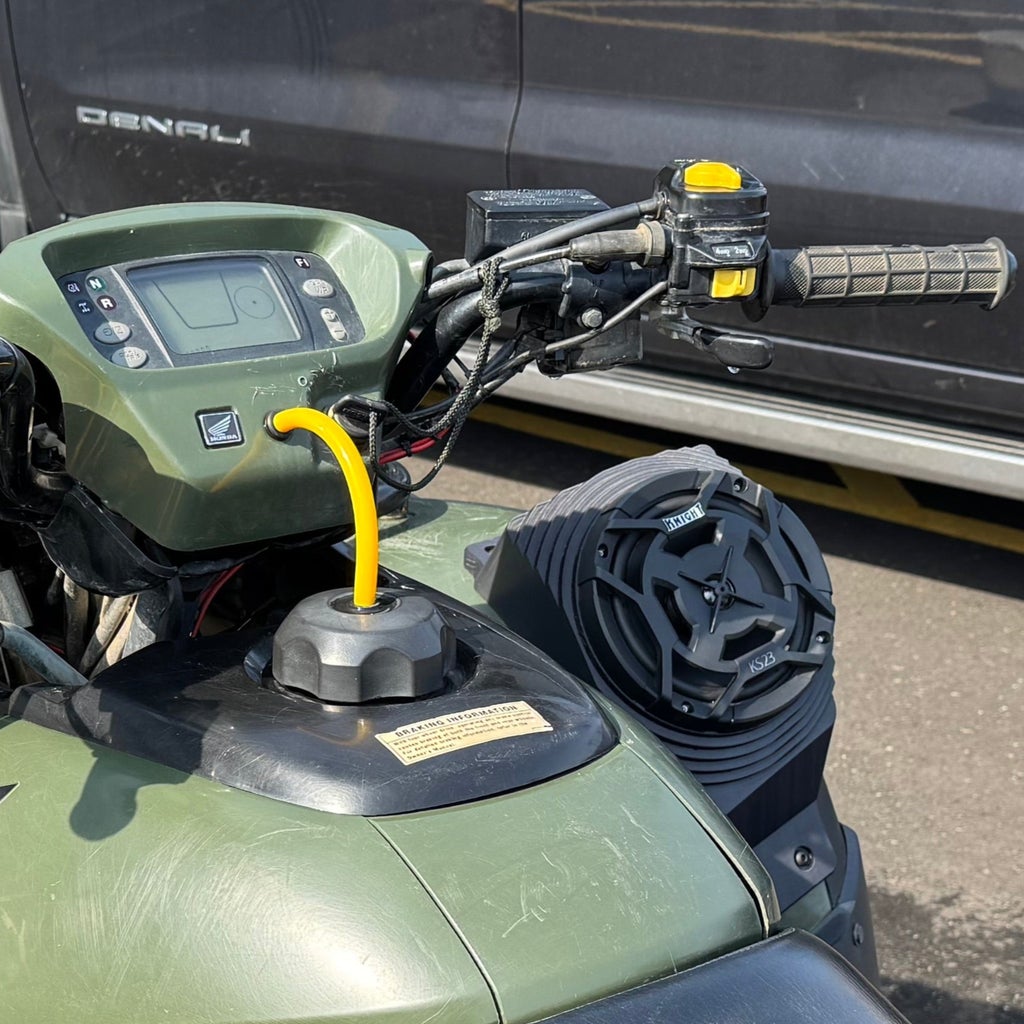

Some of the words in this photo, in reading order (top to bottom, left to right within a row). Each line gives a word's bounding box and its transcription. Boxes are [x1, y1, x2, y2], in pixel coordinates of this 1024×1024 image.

[76, 105, 251, 147] DENALI
[88, 277, 103, 290] N
[99, 297, 114, 309] R
[663, 503, 705, 531] KNIGHT
[748, 651, 776, 674] KS23
[395, 719, 445, 737] BRAKING
[446, 704, 518, 724] INFORMATION
